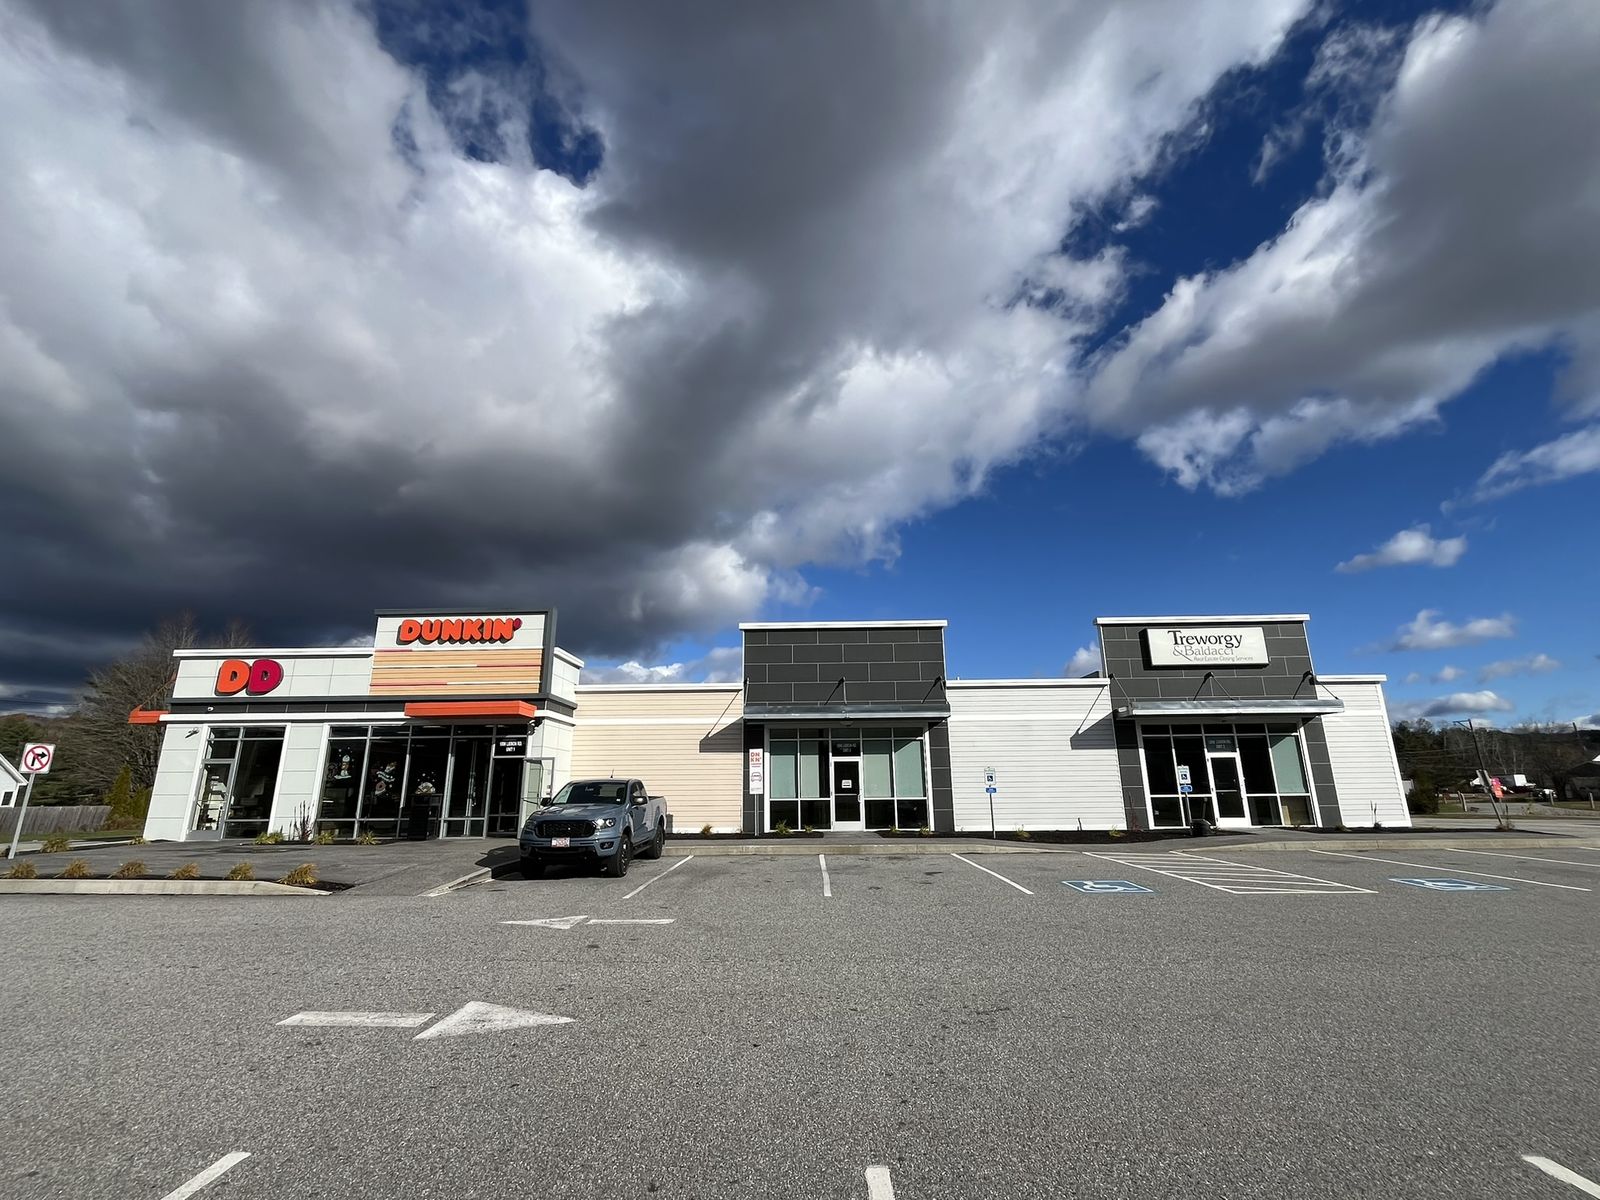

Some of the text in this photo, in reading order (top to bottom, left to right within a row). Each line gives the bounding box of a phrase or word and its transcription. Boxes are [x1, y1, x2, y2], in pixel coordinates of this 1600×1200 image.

[398, 618, 522, 643] DUNKIN'
[1167, 630, 1243, 649] Treworgy
[1184, 645, 1234, 656] Baldacci
[215, 659, 284, 695] DD
